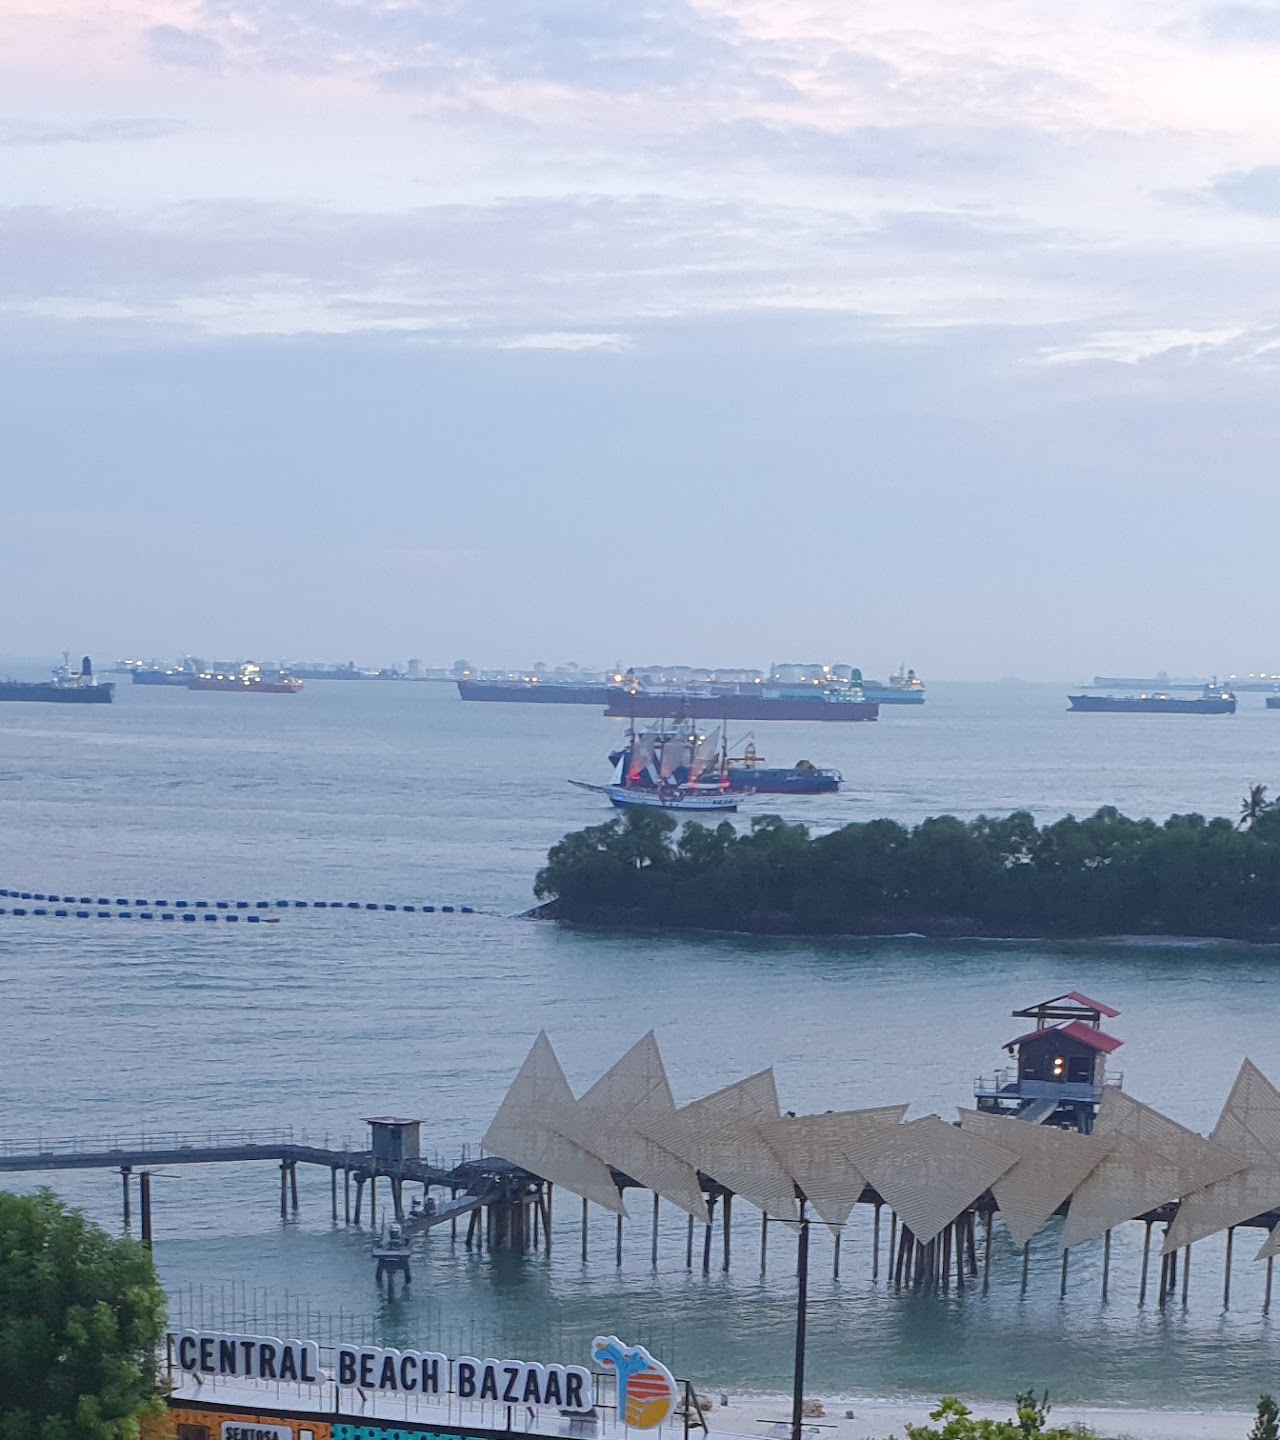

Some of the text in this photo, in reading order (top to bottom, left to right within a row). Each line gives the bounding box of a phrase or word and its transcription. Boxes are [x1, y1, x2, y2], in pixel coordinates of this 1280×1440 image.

[179, 1336, 584, 1408] CENTRAL BEACH BAZAAR
